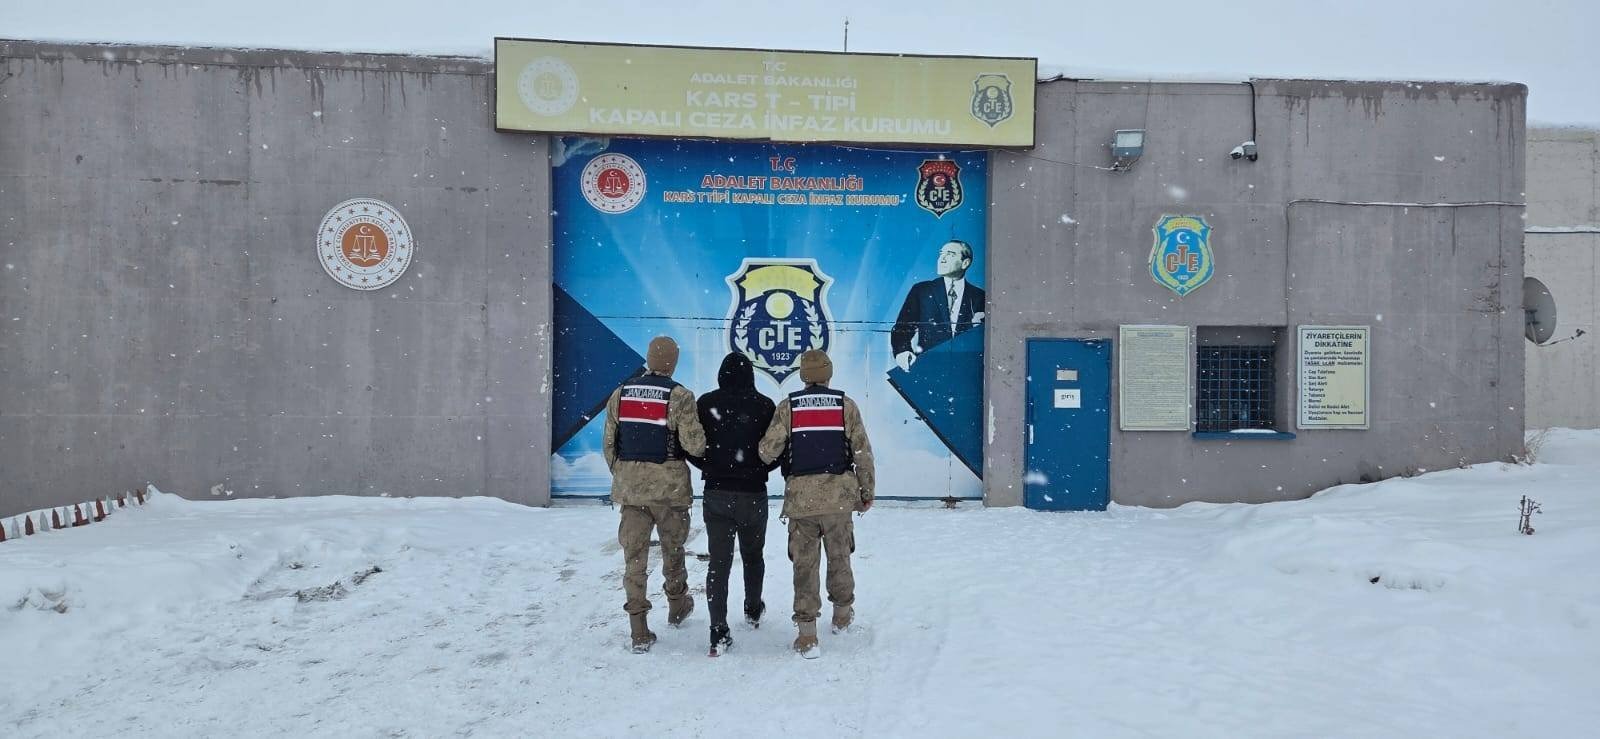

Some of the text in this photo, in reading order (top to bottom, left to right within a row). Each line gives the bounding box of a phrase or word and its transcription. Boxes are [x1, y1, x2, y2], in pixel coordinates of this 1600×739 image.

[690, 73, 857, 89] ADALET BAKANLIĞI
[686, 90, 758, 109] KARS
[764, 92, 781, 109] T
[808, 90, 856, 112] TİPİ
[589, 107, 951, 135] KAPALI CEZA İNFAZ KURUMU
[701, 174, 864, 191] ADALET BAKANLIĞI
[663, 190, 696, 203] KARS
[732, 192, 775, 205] KAPALI
[777, 193, 808, 205] CEZA
[846, 194, 899, 206] KURUMU
[929, 186, 950, 201] CTE
[1166, 245, 1199, 273] CTE
[758, 320, 802, 350] CTE
[1306, 332, 1362, 340] ZİYARETÇİLERİN
[771, 352, 791, 360] 1923
[625, 388, 664, 399] JANDARMA
[797, 397, 838, 407] JANDARMA
